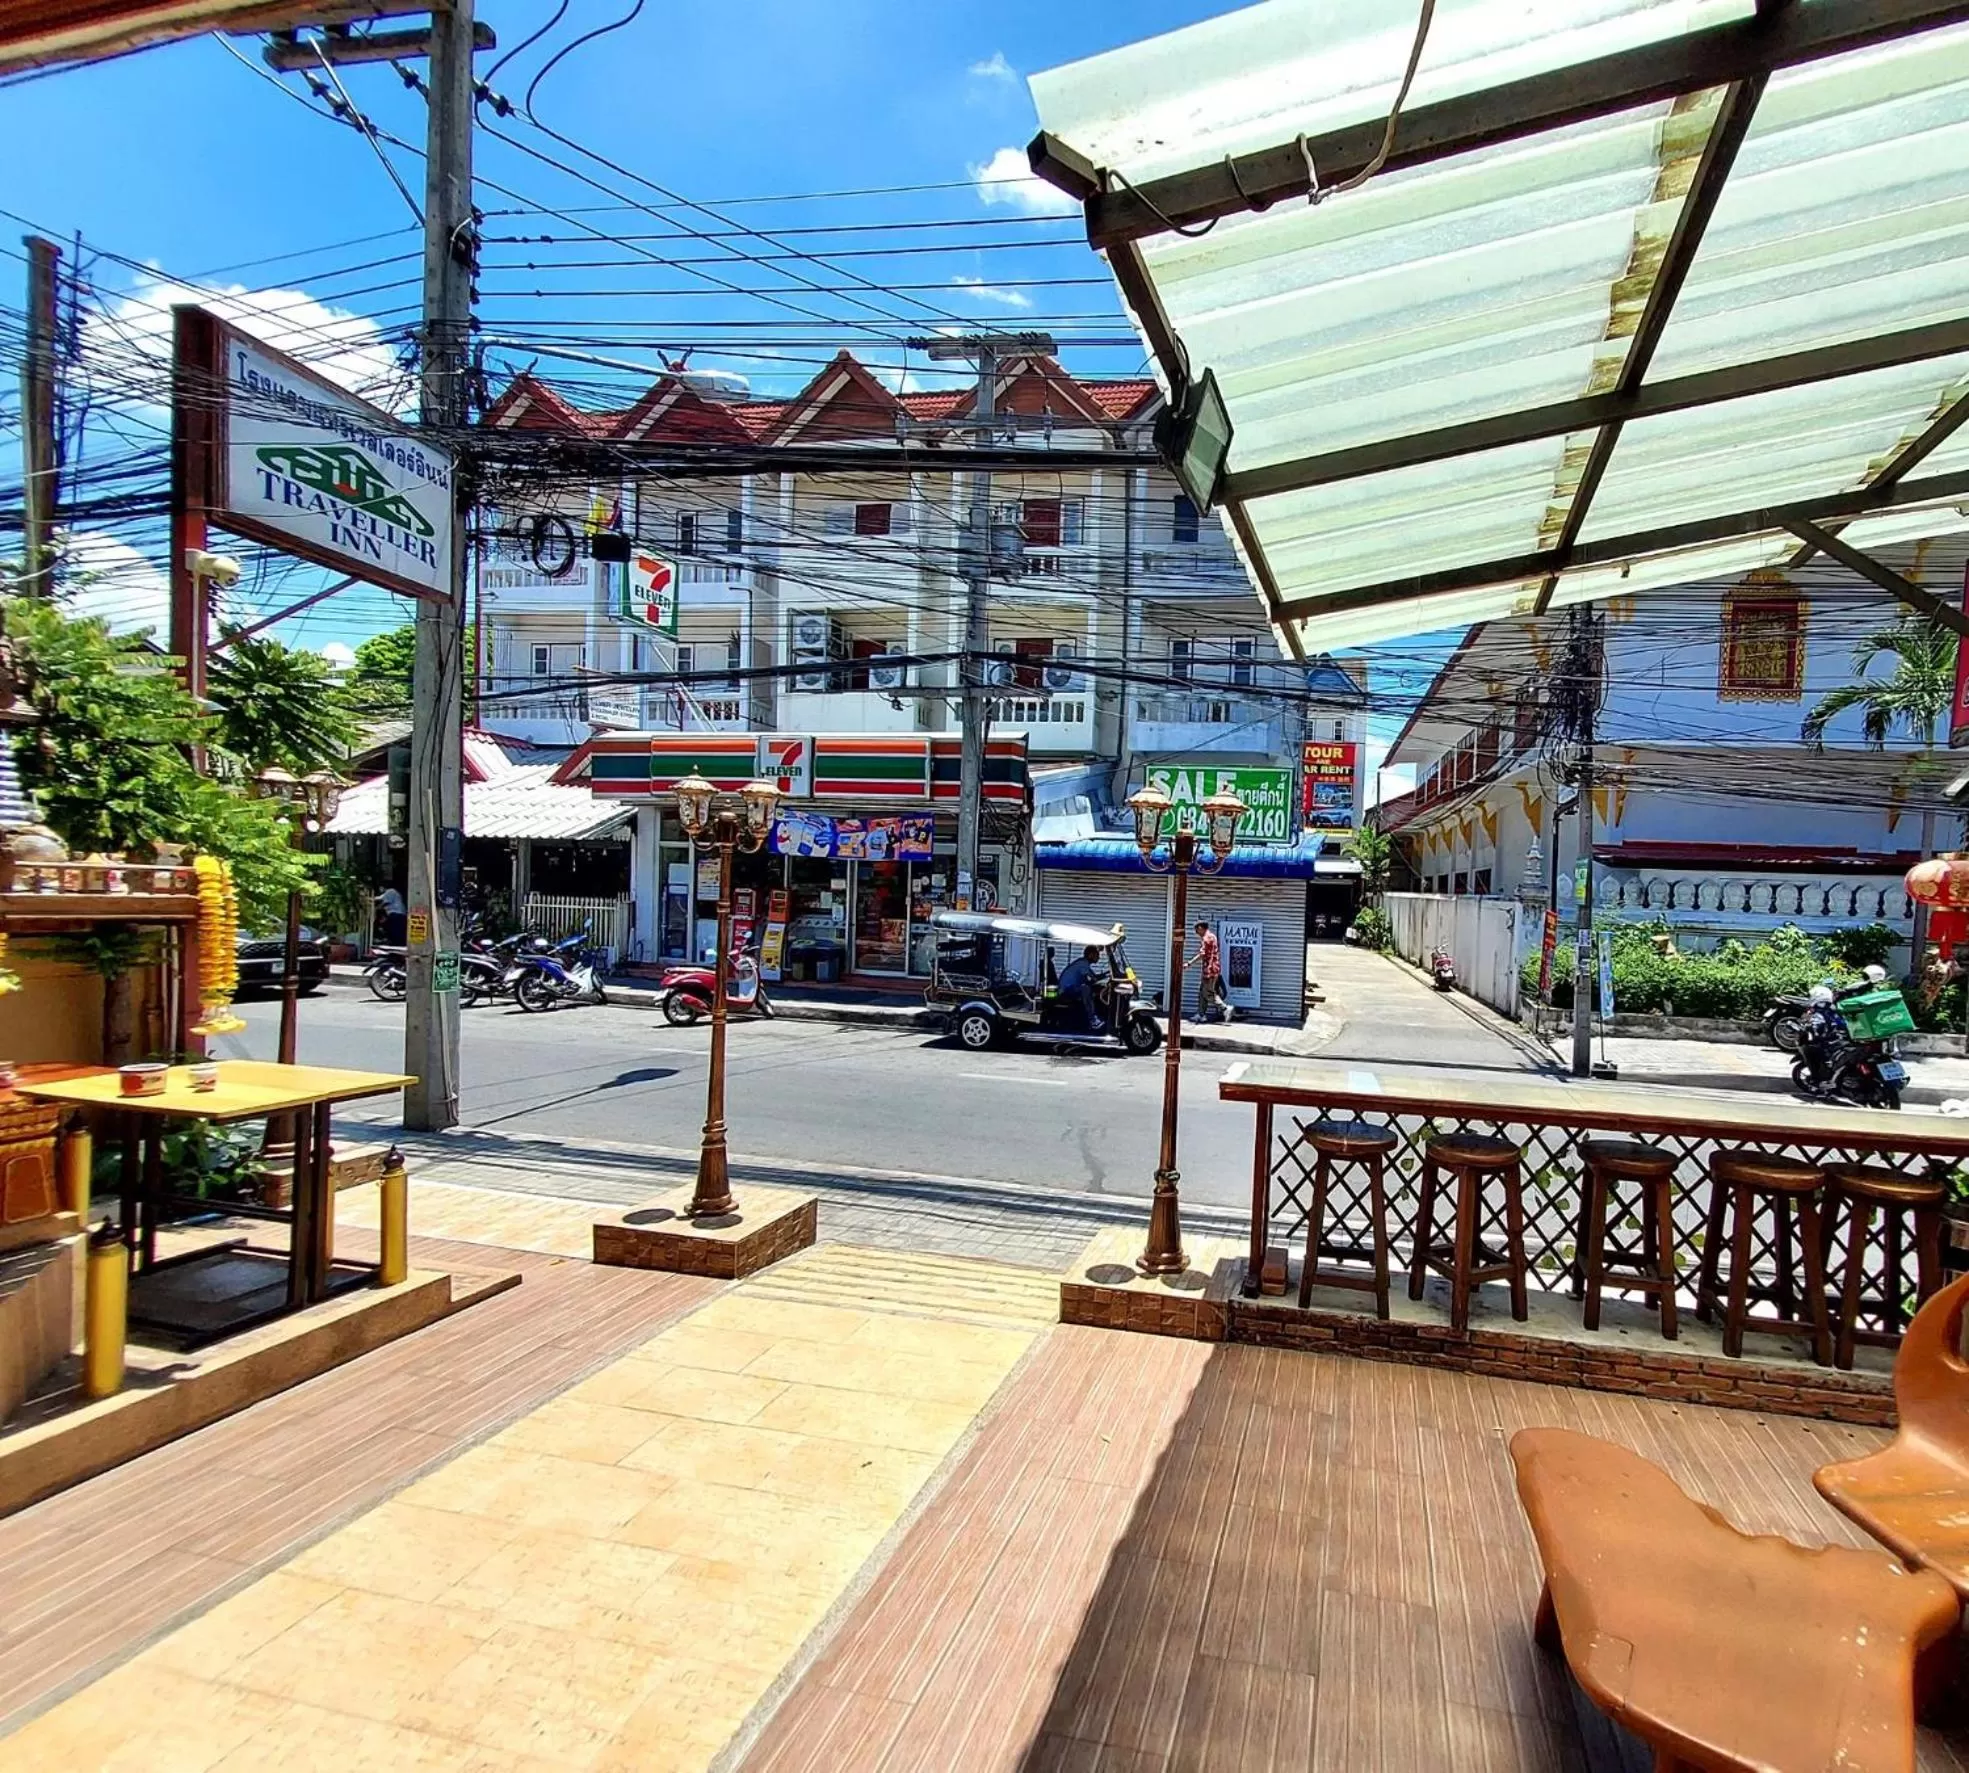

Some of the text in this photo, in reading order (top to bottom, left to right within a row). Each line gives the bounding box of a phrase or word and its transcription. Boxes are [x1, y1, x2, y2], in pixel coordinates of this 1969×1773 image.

[256, 467, 437, 568] TRAVELLER
[330, 521, 382, 560] INN
[1152, 770, 1237, 805] SALE
[1320, 766, 1351, 775] RENT
